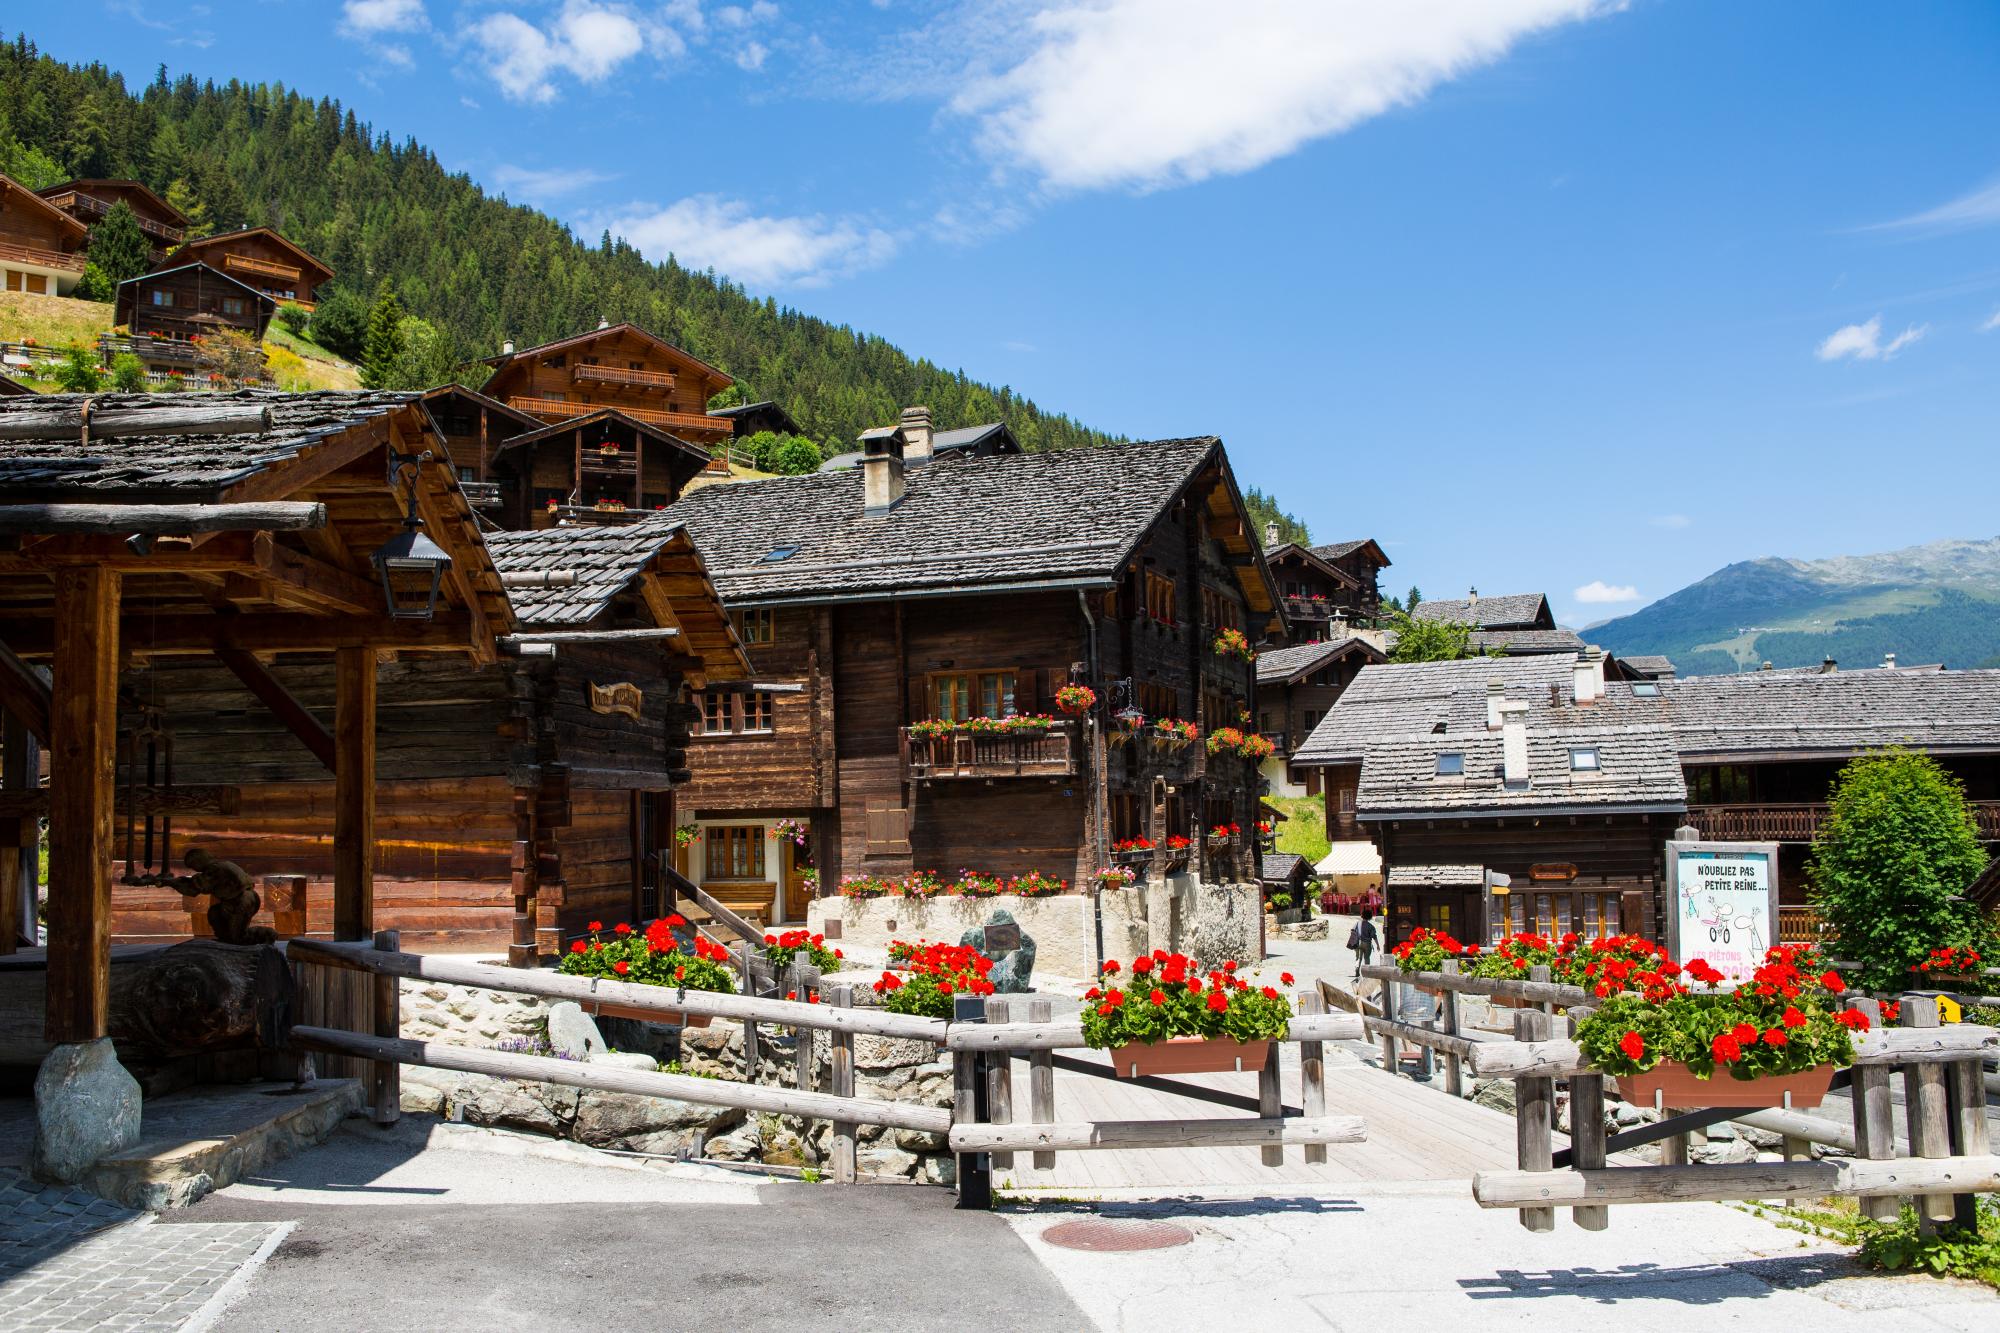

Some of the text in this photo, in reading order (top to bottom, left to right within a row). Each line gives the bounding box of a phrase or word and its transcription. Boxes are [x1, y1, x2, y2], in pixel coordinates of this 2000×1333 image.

[1698, 864, 1755, 876] N'OUBLIEZ PAS
[1704, 878, 1731, 890] PETITE
